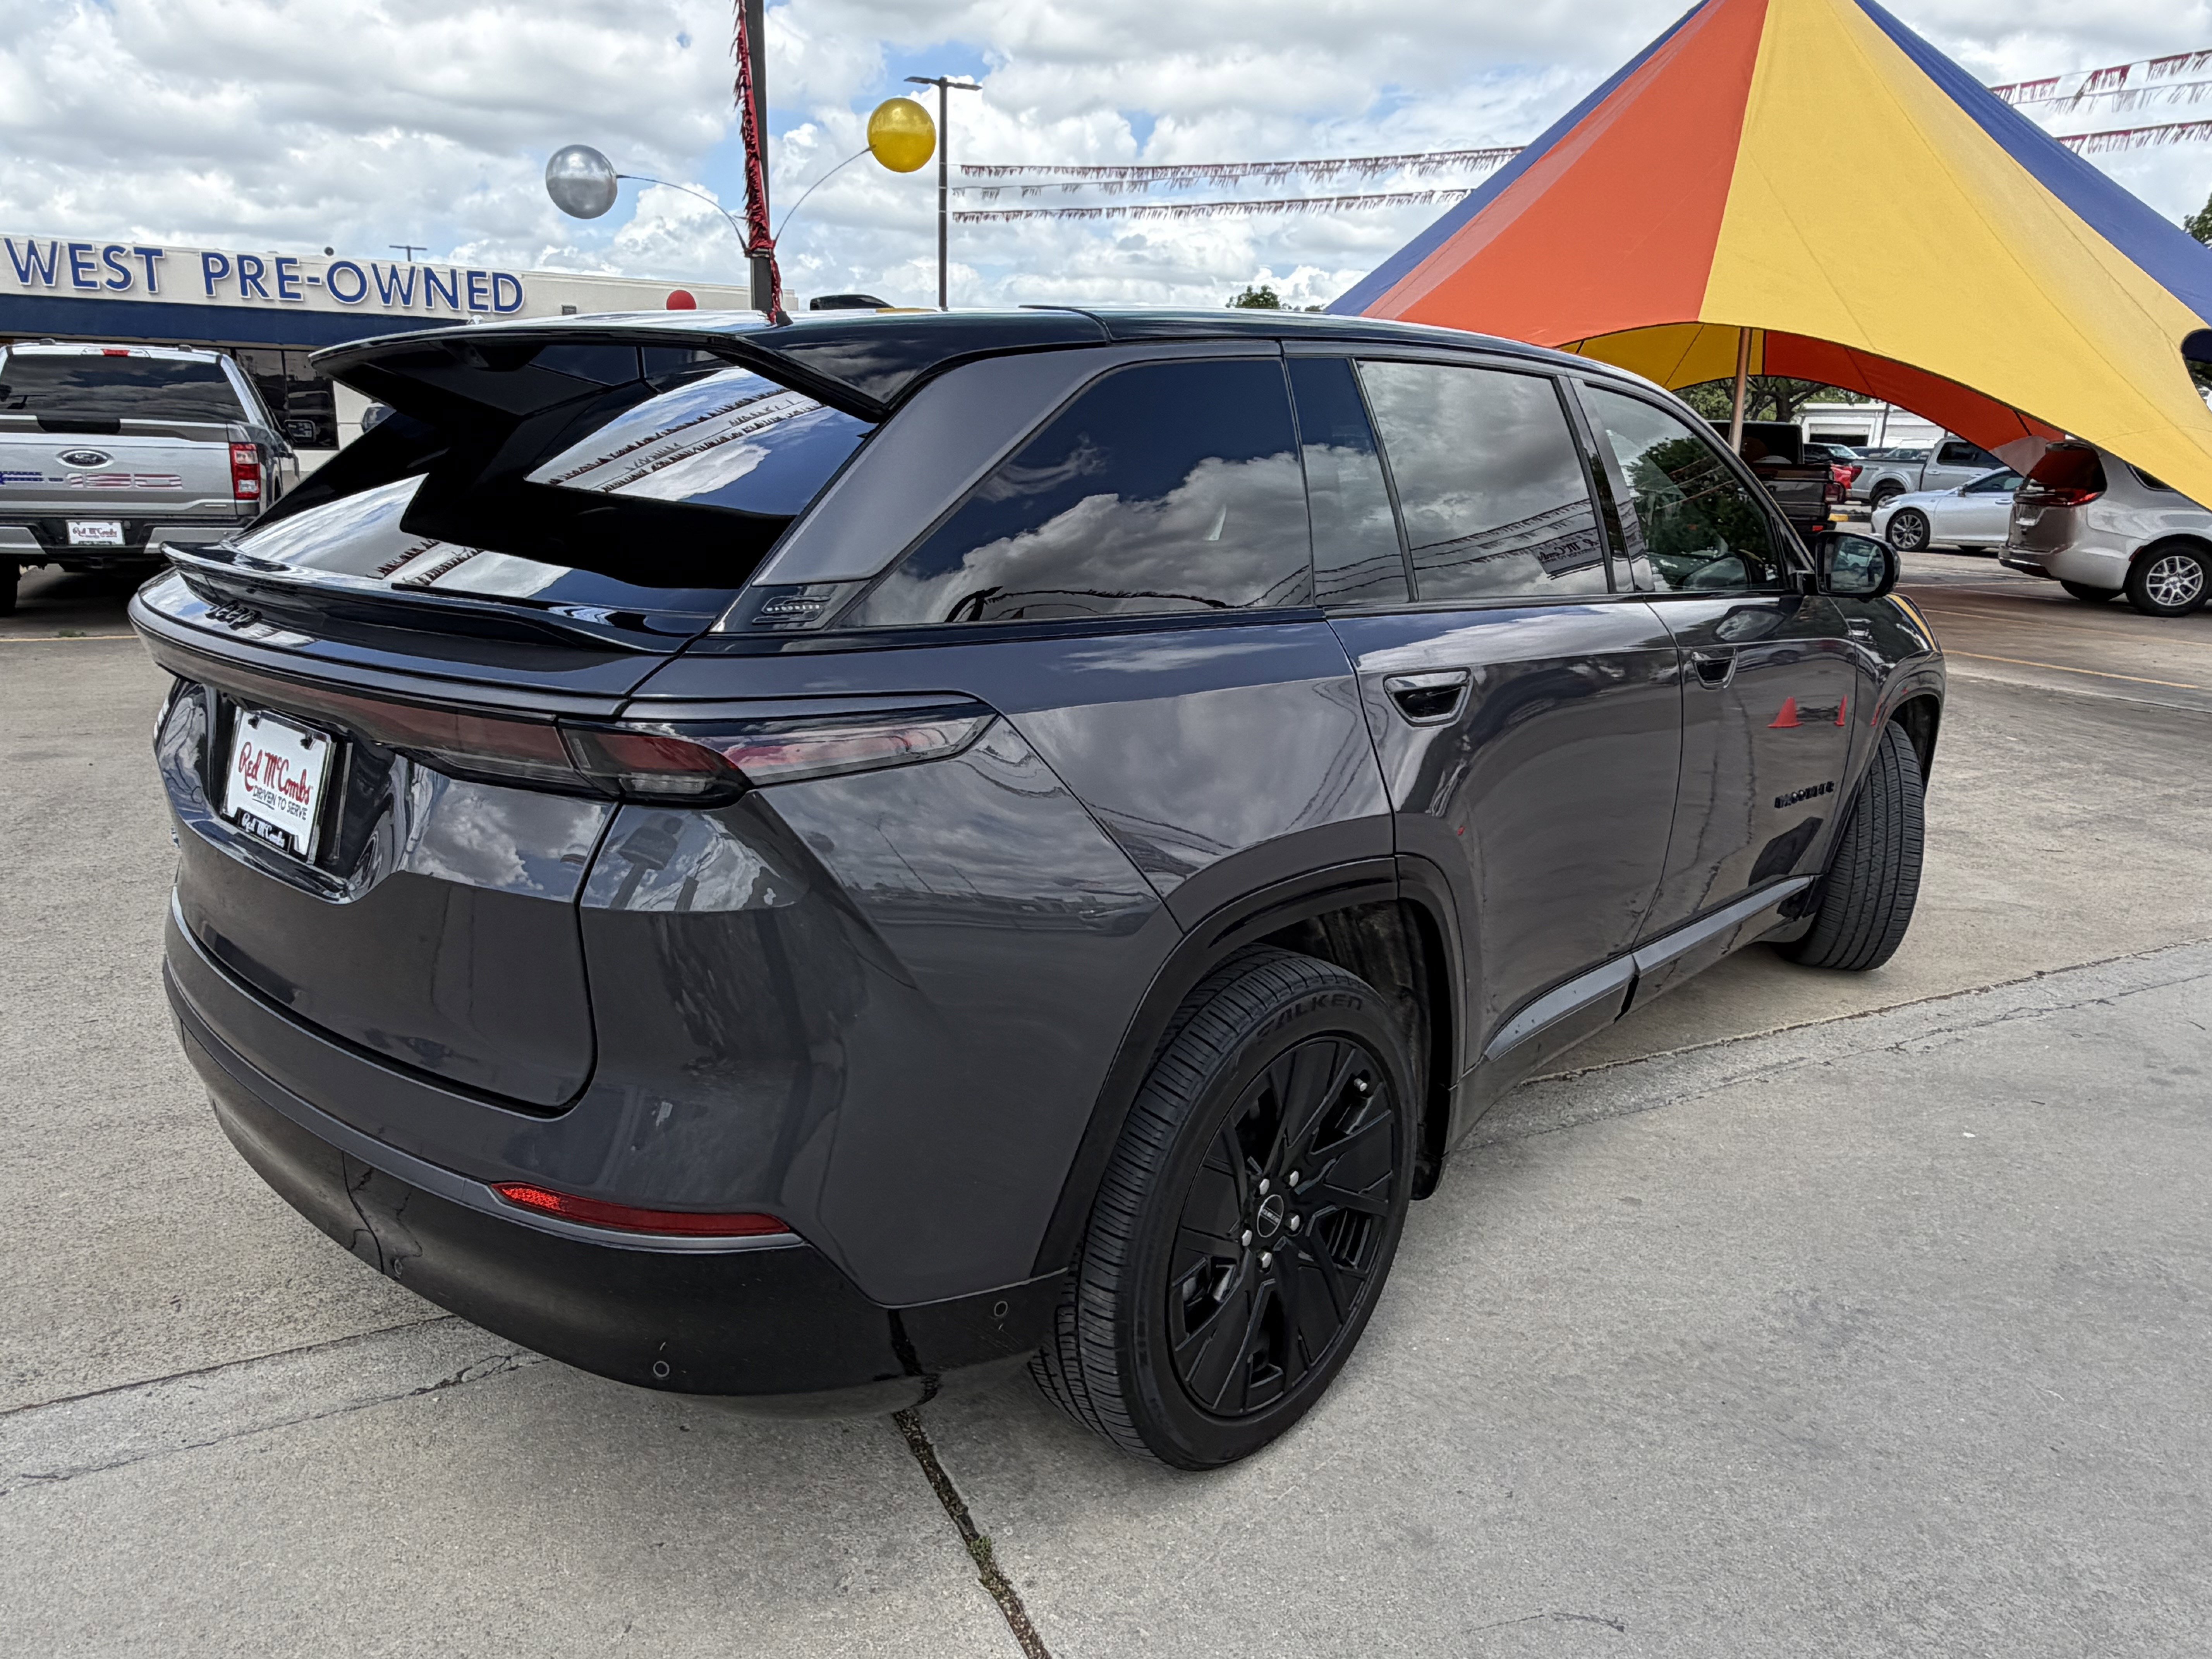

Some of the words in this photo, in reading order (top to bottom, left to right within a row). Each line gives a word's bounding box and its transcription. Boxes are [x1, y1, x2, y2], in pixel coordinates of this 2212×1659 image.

[3, 237, 165, 294] WEST
[201, 251, 526, 314] PRE-OWNED
[238, 742, 263, 792] Red
[264, 752, 310, 805] McCombs
[253, 785, 275, 805] DRIVEN
[276, 796, 287, 811] TO
[287, 801, 308, 820] SERVE
